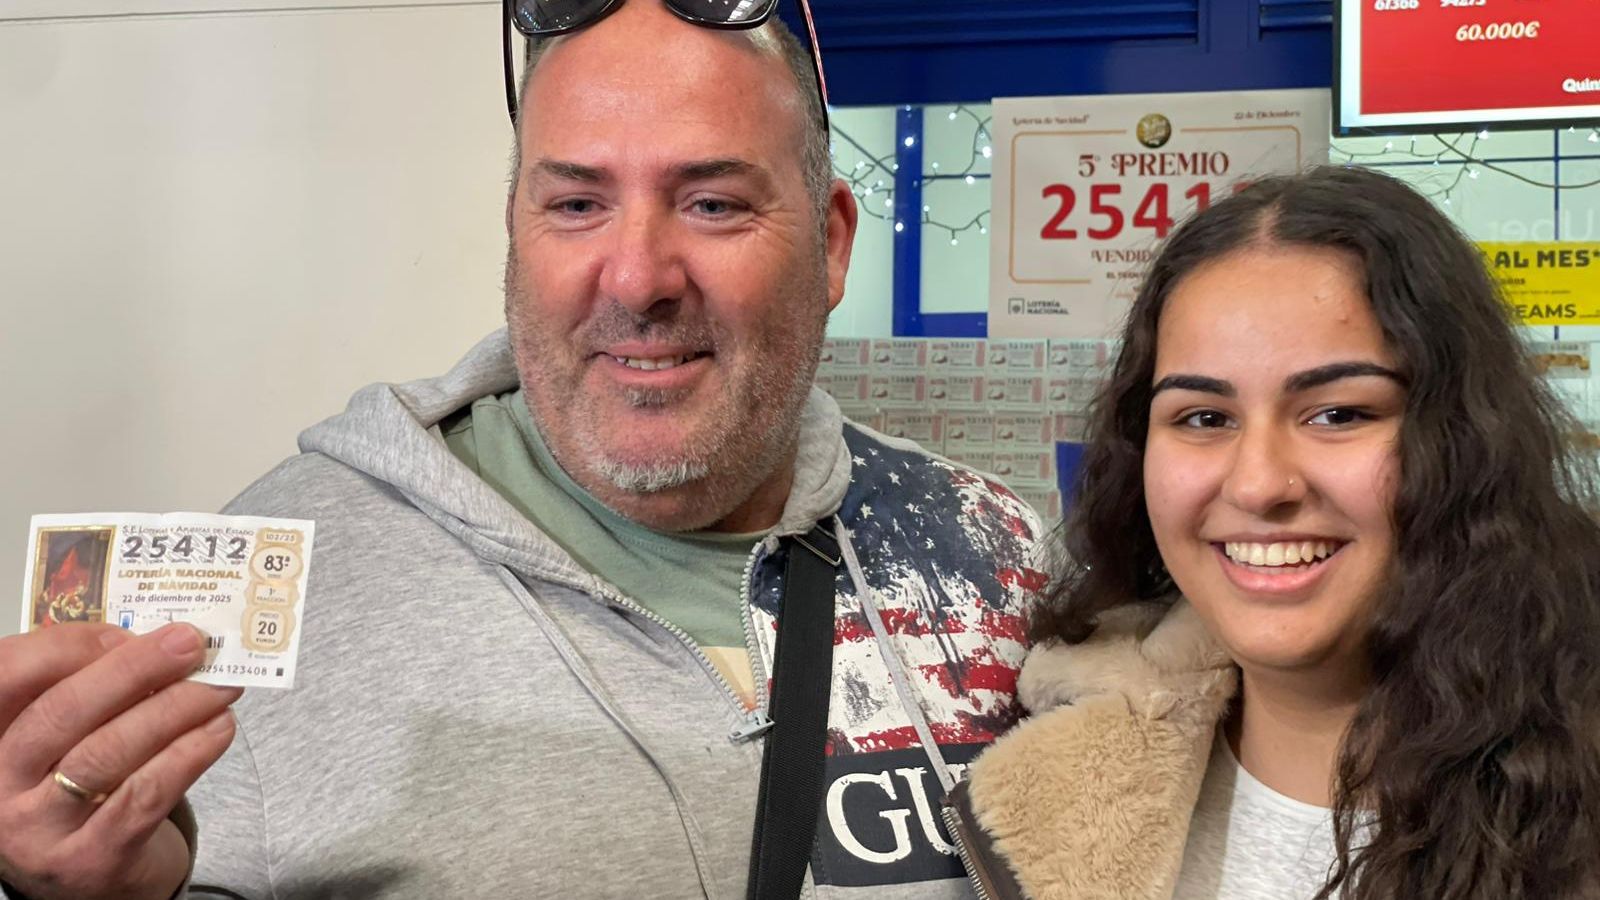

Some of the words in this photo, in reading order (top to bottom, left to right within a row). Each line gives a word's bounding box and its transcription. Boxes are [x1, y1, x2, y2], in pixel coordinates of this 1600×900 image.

[1455, 20, 1541, 42] 60.000€
[1562, 77, 1600, 94] Quin
[1111, 151, 1230, 177] PREMIO
[1041, 182, 1253, 240] 2541
[1091, 249, 1153, 264] VENDID
[1495, 251, 1529, 268] AL
[1027, 308, 1069, 316] NACIONAL
[1515, 304, 1577, 319] EAMS
[122, 535, 247, 560] 25412
[118, 567, 172, 579] LOTERÍA
[176, 569, 243, 580] NACIONAL
[138, 582, 155, 591] DE
[158, 581, 218, 591] NAVIDAD
[122, 595, 132, 603] 22
[135, 595, 146, 603] de
[148, 594, 192, 603] diciembre
[195, 595, 206, 603] de
[209, 595, 232, 603] 2025
[258, 621, 278, 636] 20
[826, 763, 970, 864] GU
